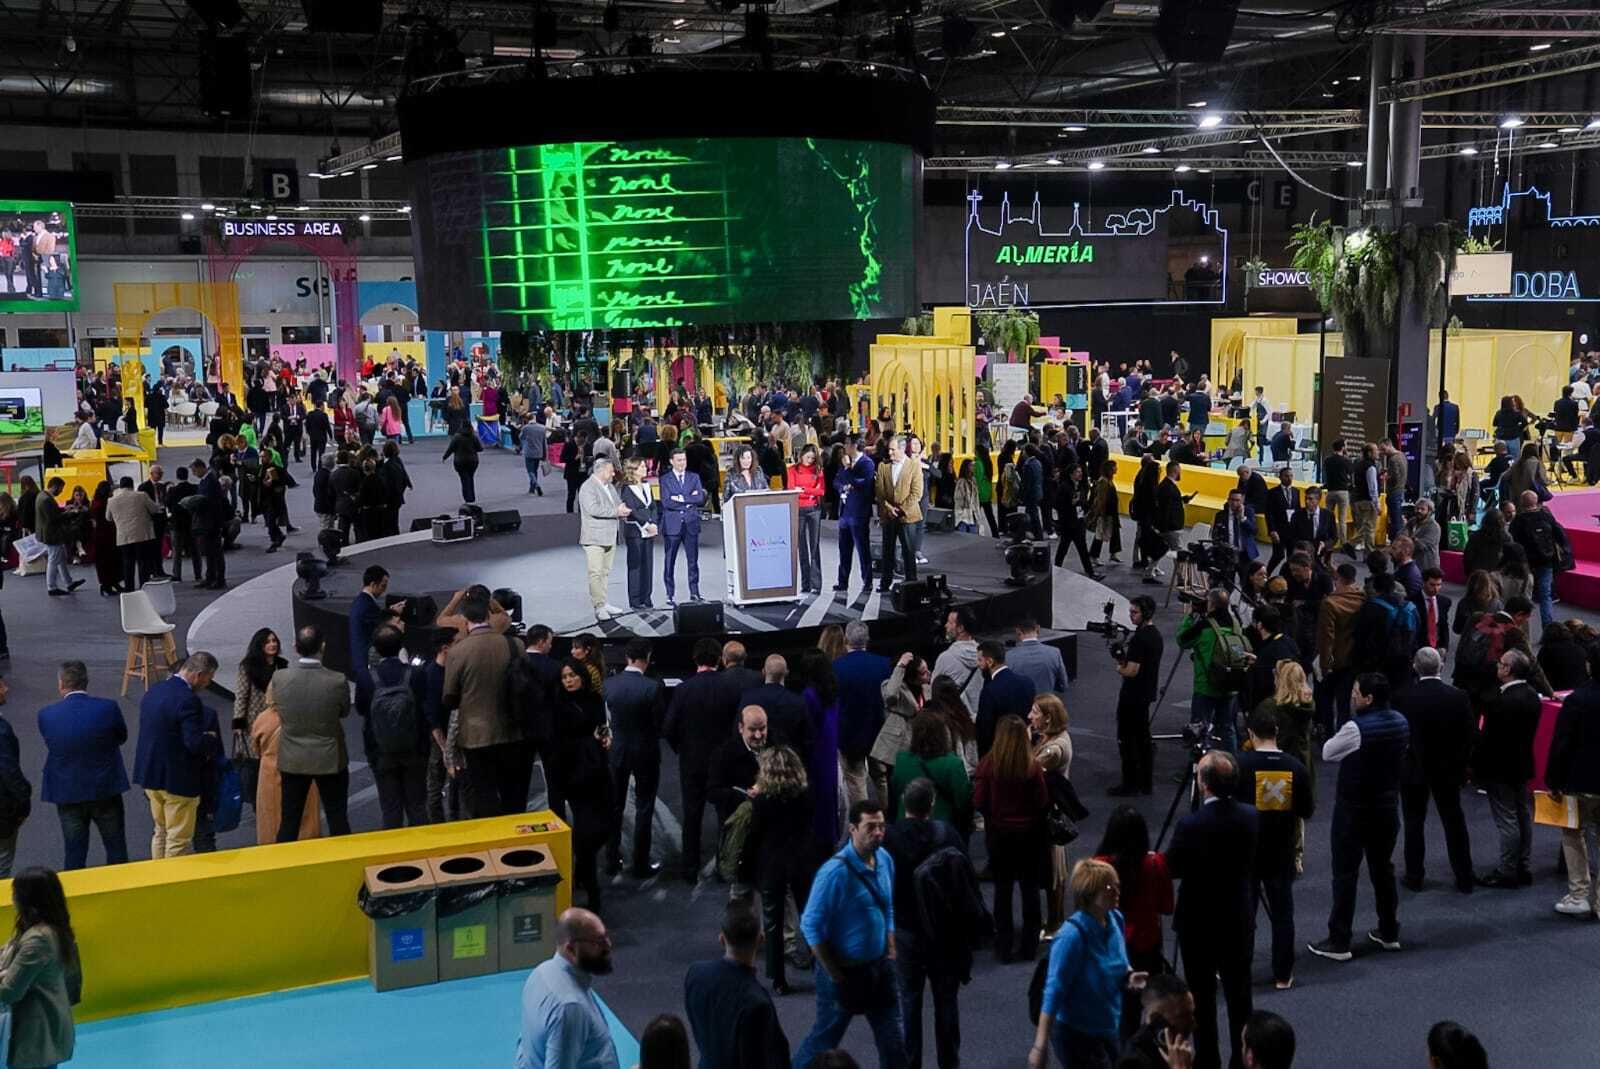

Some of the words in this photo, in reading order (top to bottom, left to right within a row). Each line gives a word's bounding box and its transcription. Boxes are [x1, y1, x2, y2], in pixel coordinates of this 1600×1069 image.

[272, 173, 291, 198] B
[1247, 181, 1260, 201] C
[1281, 185, 1293, 205] E
[224, 222, 296, 236] BUSINESS
[303, 222, 343, 236] AREA
[996, 241, 1093, 266] ALMERÍA
[969, 275, 1029, 307] JAÉN
[1472, 270, 1580, 298] DOBA
